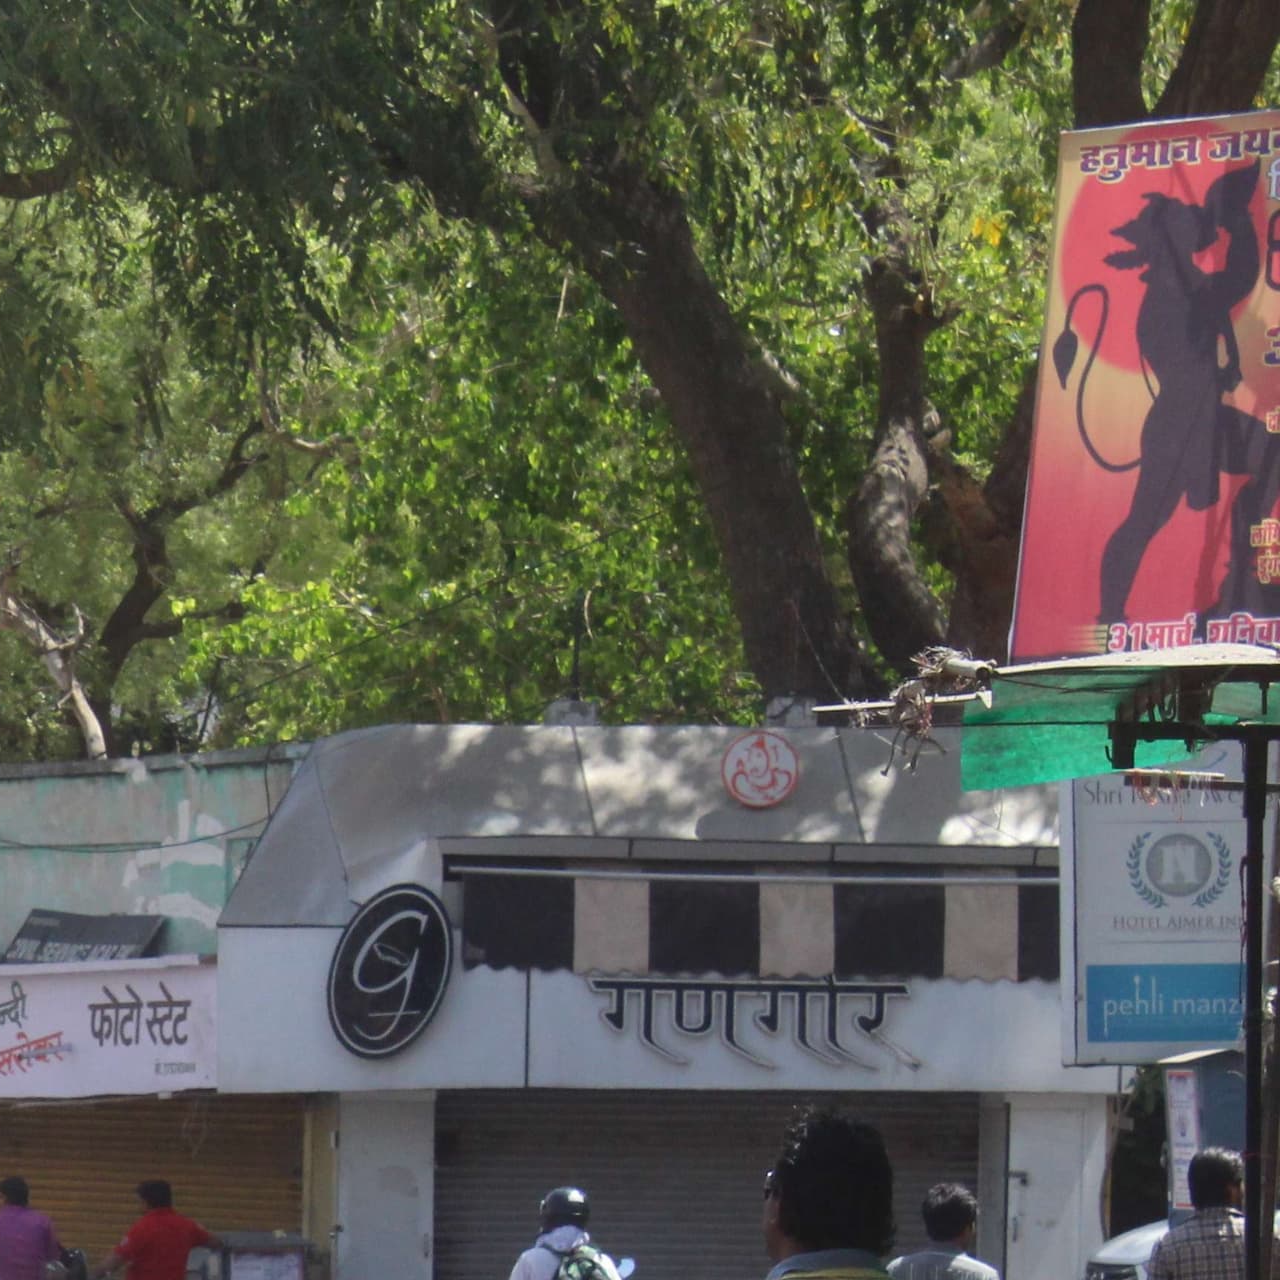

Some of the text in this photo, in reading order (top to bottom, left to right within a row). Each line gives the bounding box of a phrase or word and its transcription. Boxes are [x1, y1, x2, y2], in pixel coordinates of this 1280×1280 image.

[1079, 136, 1200, 183] हनुमान
[1113, 916, 1161, 930] HOTEL
[1167, 915, 1217, 930] AJMER
[87, 980, 193, 1047] फोटो स्टेट
[1102, 974, 1164, 1040] pehli
